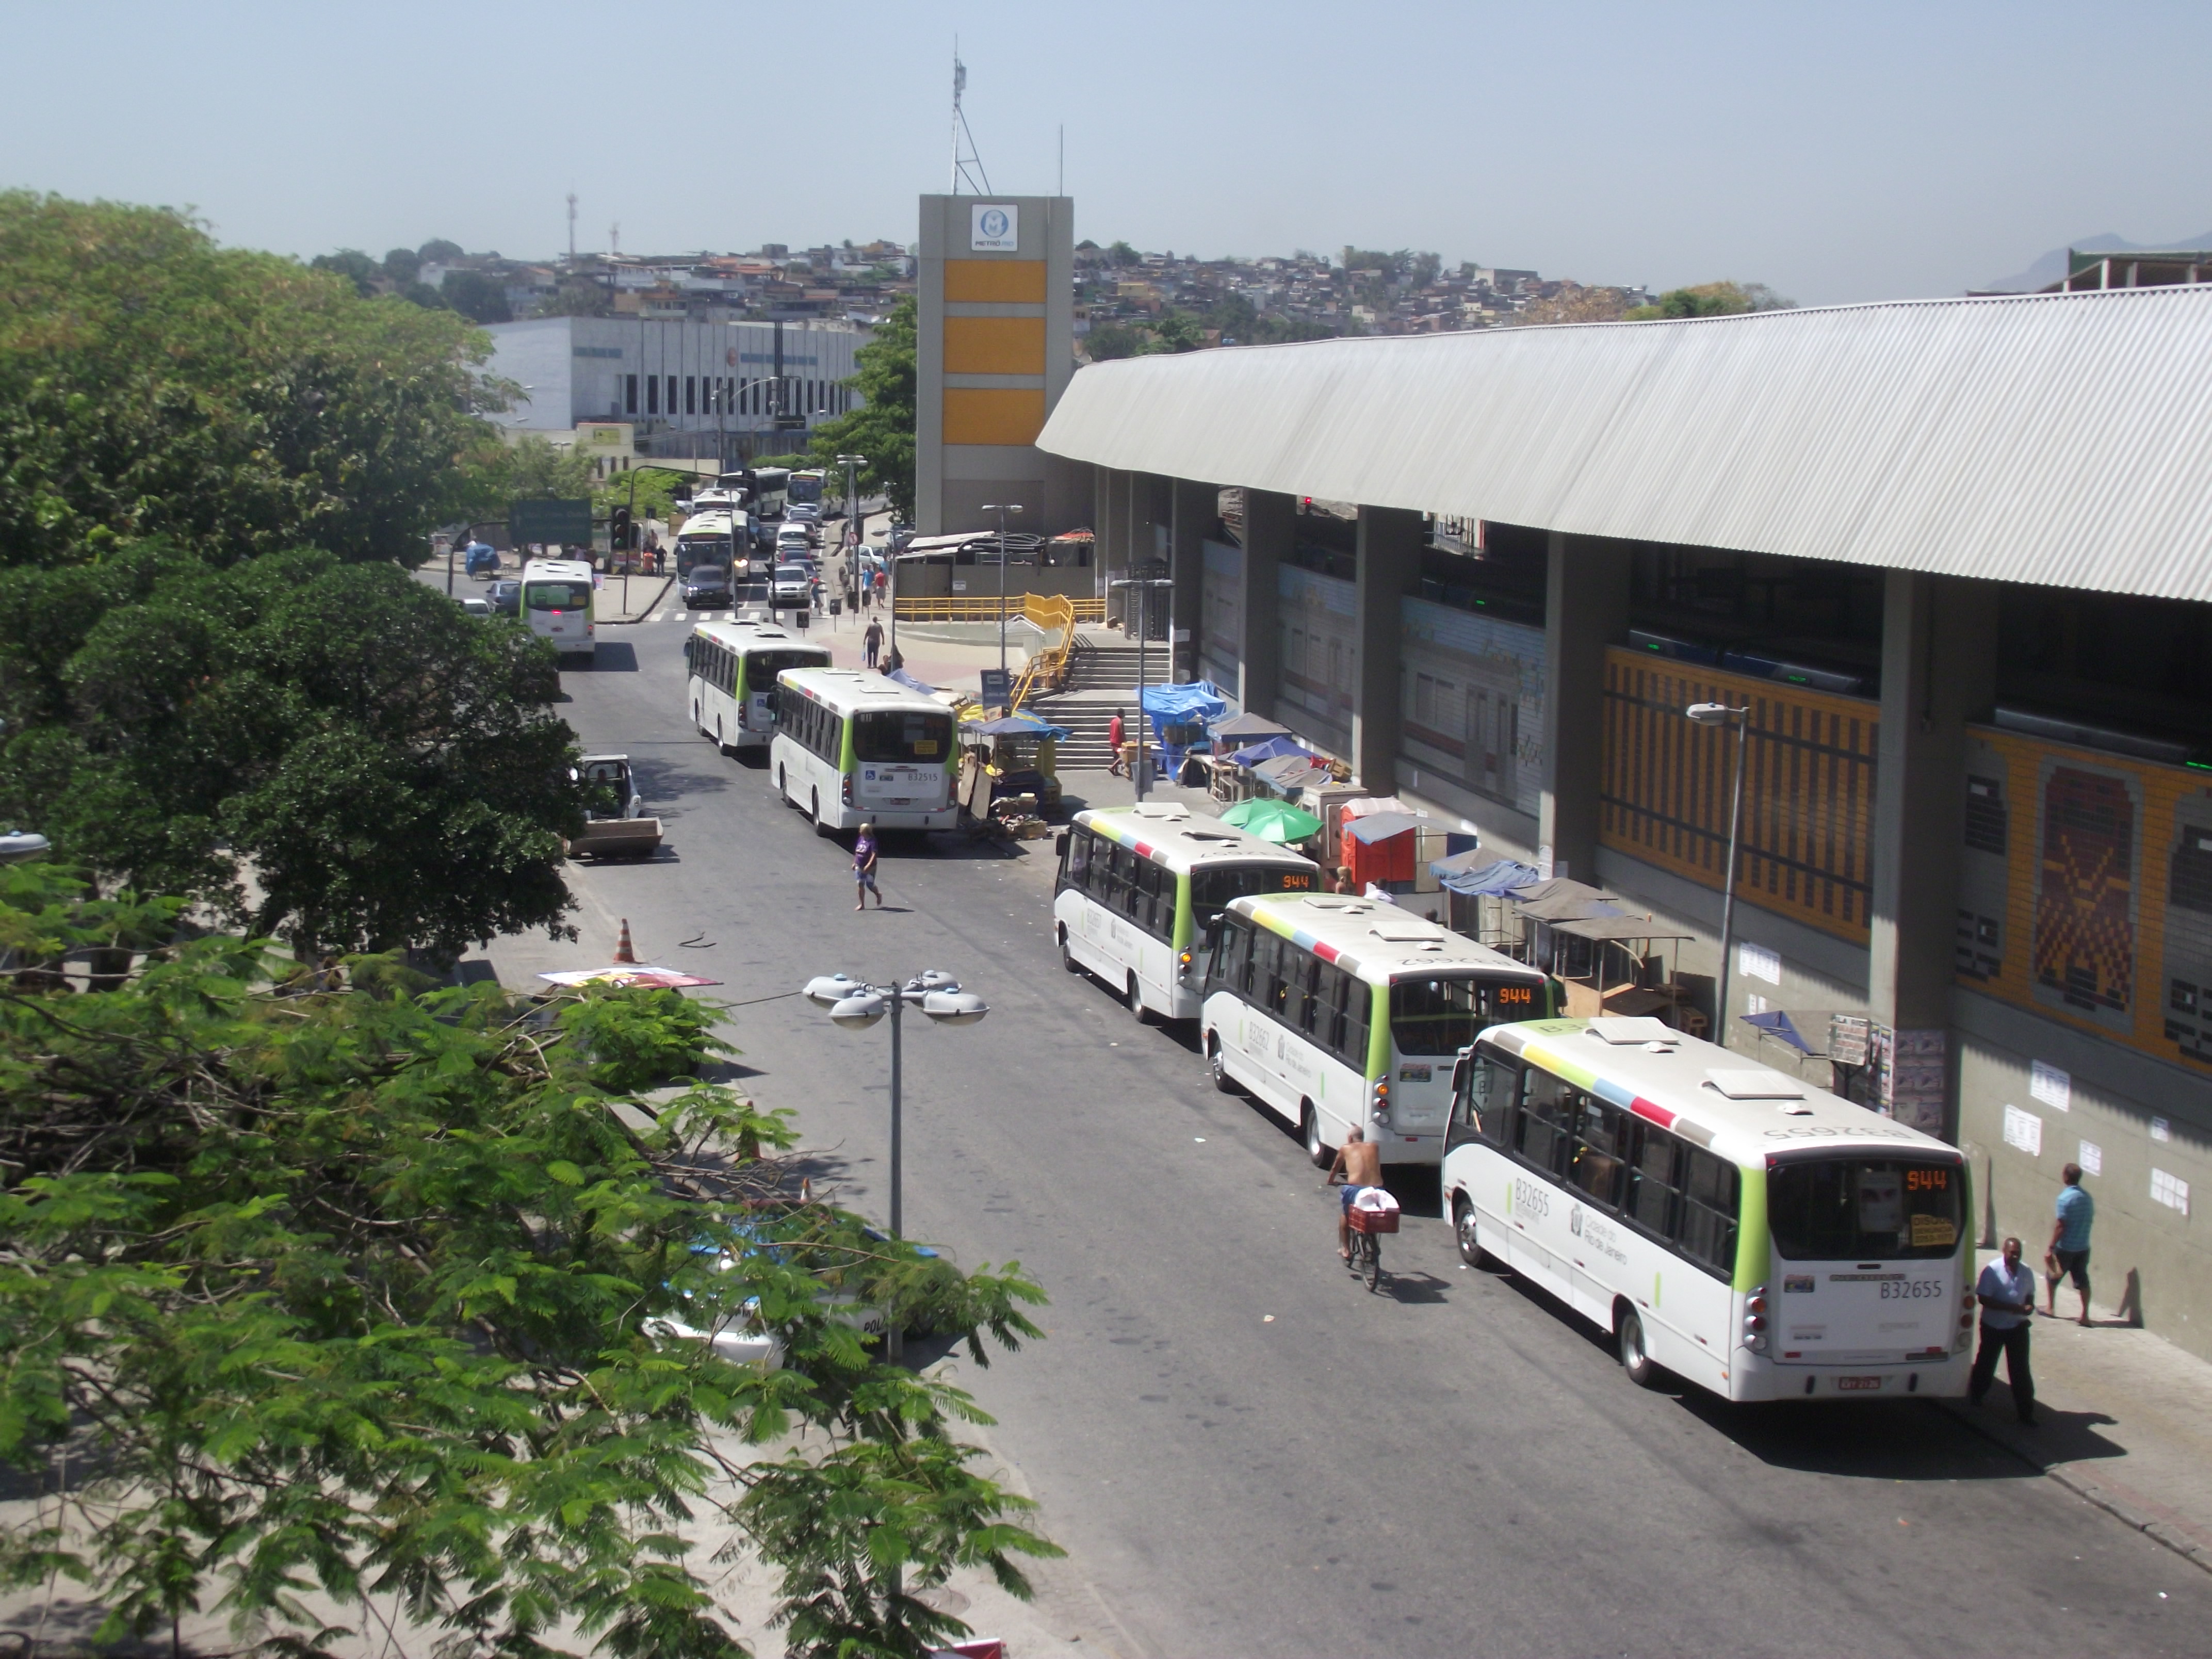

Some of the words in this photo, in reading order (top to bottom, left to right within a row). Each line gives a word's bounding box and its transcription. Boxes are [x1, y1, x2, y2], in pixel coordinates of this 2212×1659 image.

[908, 773, 938, 781] B32515
[1283, 875, 1309, 888] 944
[1499, 988, 1531, 1004] 944
[1249, 1021, 1269, 1051] B32662
[1763, 1126, 1913, 1140] B32655
[1516, 1177, 1550, 1217] B32655
[1585, 1214, 1607, 1237] Cidade
[1585, 1229, 1595, 1246] Rio
[1595, 1238, 1604, 1251] de
[1881, 1281, 1942, 1298] B32655
